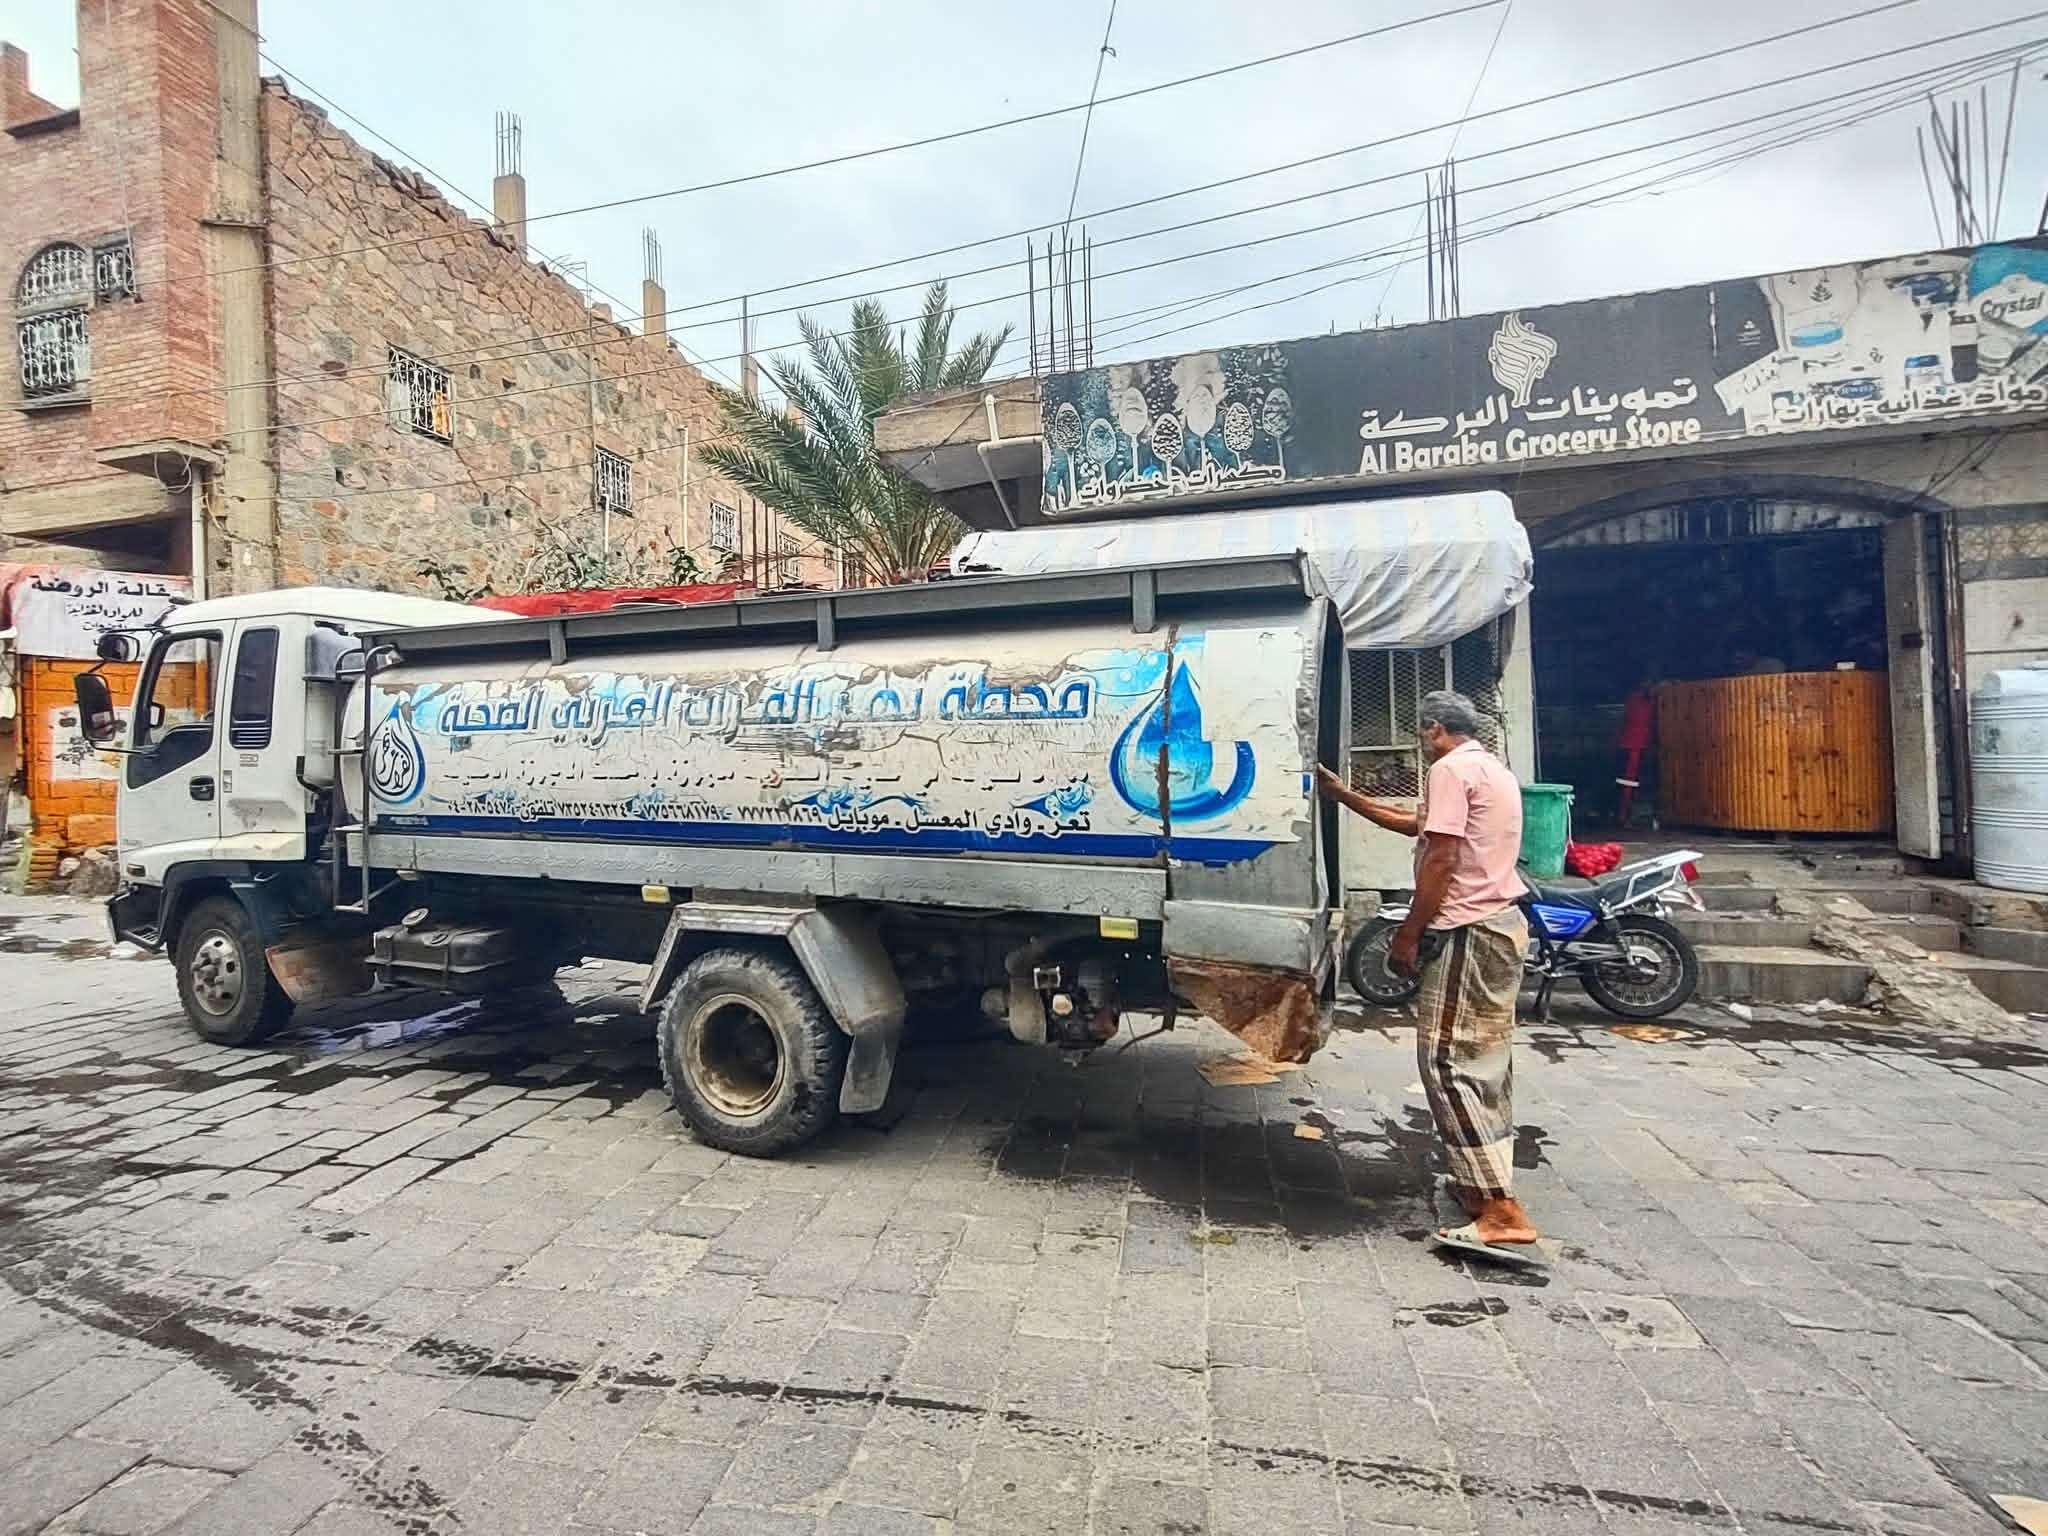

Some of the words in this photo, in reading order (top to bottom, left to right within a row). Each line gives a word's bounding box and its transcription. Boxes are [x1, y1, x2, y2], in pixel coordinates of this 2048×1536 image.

[1525, 377, 1698, 422] تموينات
[1359, 393, 1510, 439] البركة
[1360, 443, 1388, 475] Al
[1505, 427, 1618, 460] Grocery
[1625, 415, 1701, 449] Store
[31, 575, 109, 598] الروضة
[118, 580, 170, 598] قالة
[938, 672, 1091, 721] محطة
[551, 685, 673, 746] العربي
[520, 800, 555, 820] تلفون
[828, 805, 889, 831] موبايل
[905, 806, 978, 831] المعسل
[985, 810, 1032, 835] وادي
[1051, 808, 1091, 835] تعز
